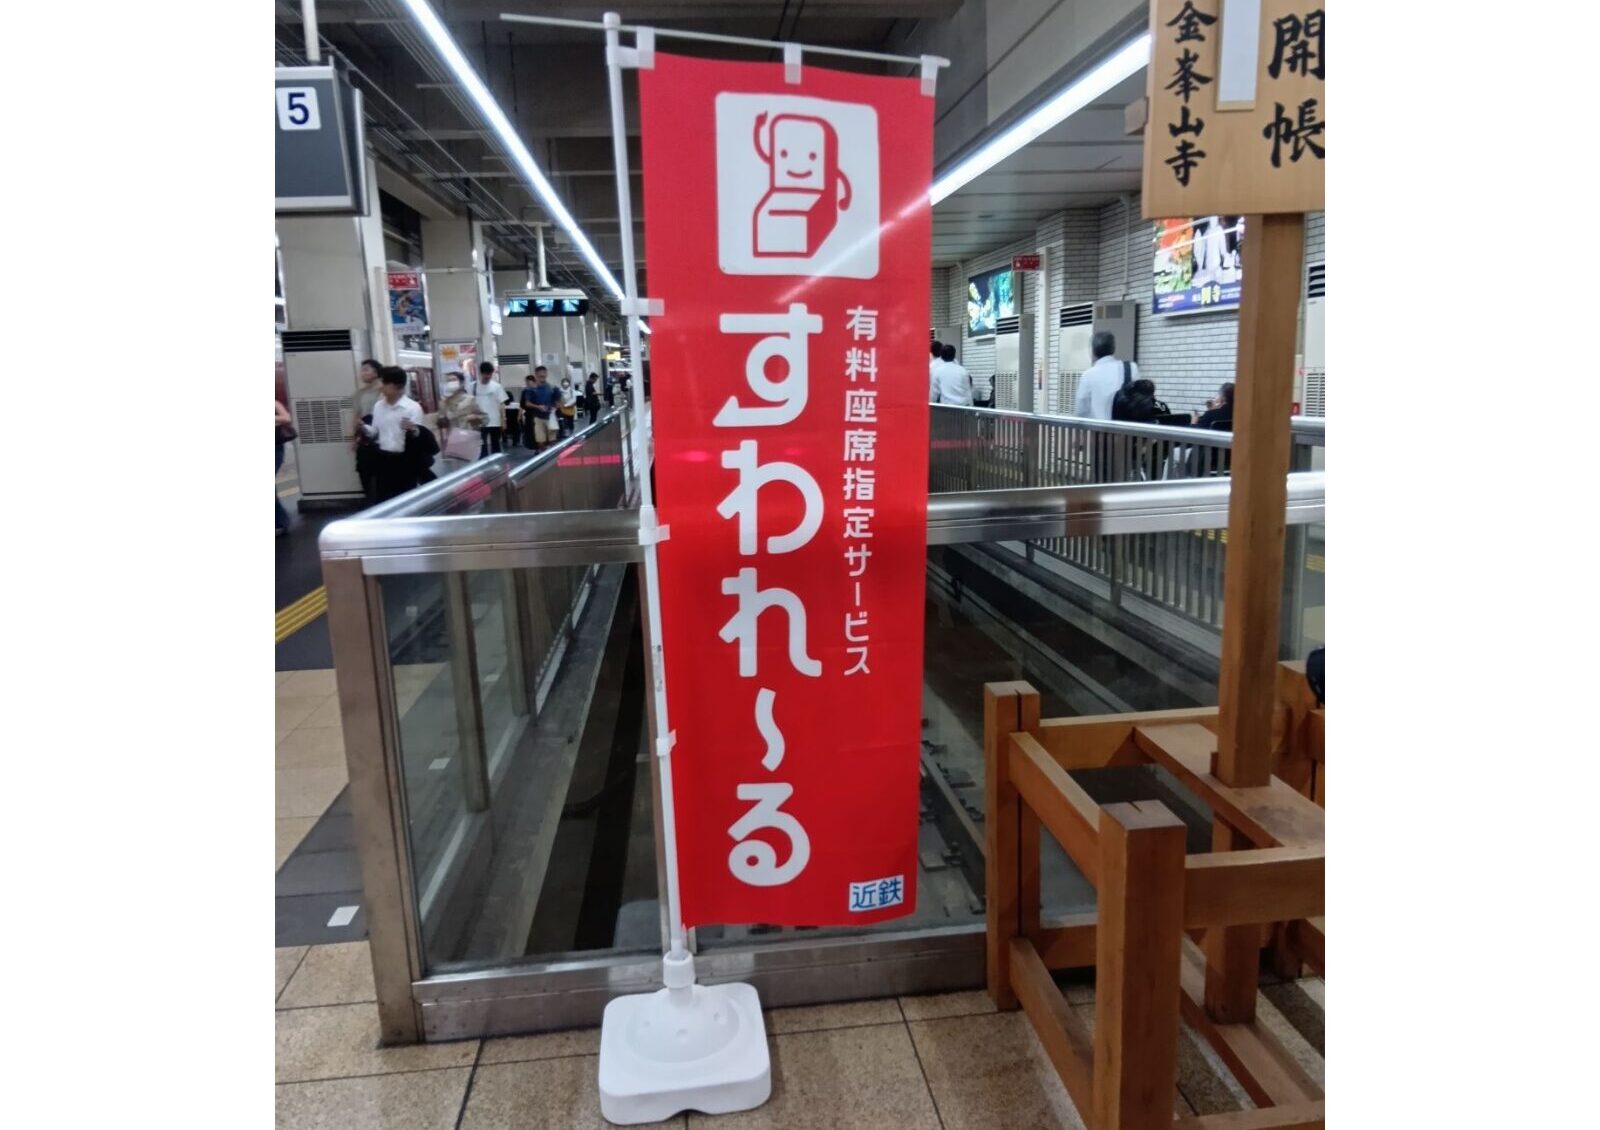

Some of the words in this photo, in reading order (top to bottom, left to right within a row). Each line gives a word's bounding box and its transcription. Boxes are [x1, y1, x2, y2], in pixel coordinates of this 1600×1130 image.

[288, 92, 309, 125] 5
[1165, 0, 1218, 187] 金峯山寺
[1263, 9, 1325, 168] 開帳
[842, 305, 878, 676] 有料座席指定サービス
[852, 878, 902, 909] 近鉄
